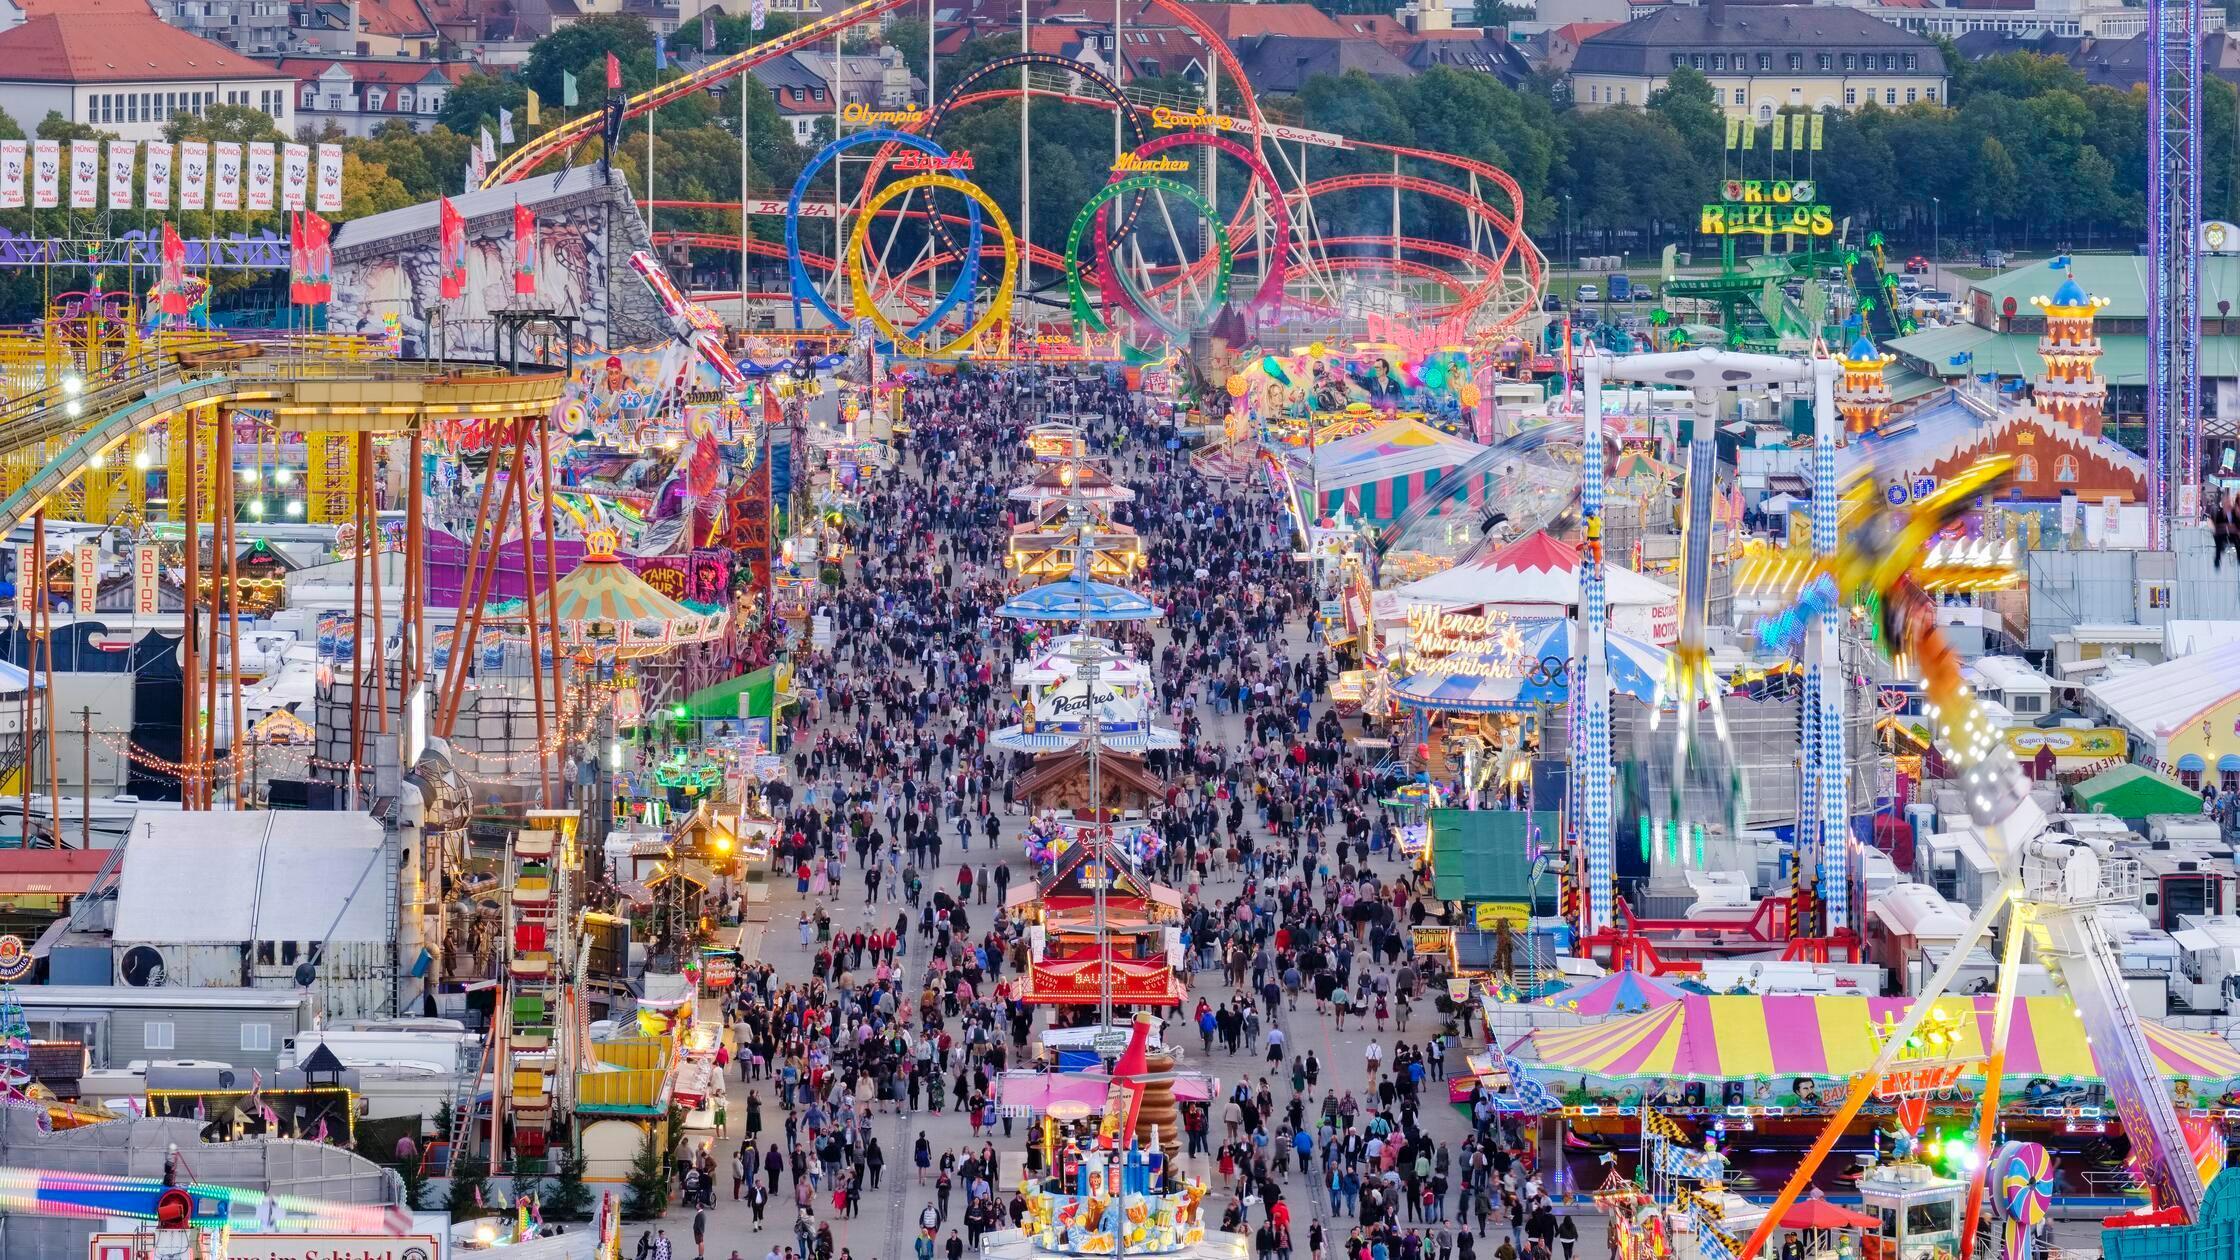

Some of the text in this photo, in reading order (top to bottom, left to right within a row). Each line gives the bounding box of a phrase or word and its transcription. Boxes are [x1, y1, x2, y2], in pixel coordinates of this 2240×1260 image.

[843, 103, 923, 125] Olympia
[1152, 106, 1231, 131] Looping
[1276, 127, 1336, 146] Looping
[893, 150, 974, 169] Barth
[1110, 152, 1190, 171] München
[1744, 180, 1791, 202] RIO
[754, 202, 830, 216] Bath
[1702, 205, 1834, 235] RAPIDOS
[1036, 335, 1071, 344] asse
[24, 548, 34, 611] ROTOR
[81, 549, 92, 612] ROTOR
[142, 550, 153, 613] ROTOR
[640, 568, 686, 588] FAHRT
[1417, 606, 1508, 636] Menzel's
[1417, 635, 1494, 653] Münchner
[1406, 654, 1514, 678] Zugspitzbahn
[1036, 973, 1059, 985] WIESN
[1142, 974, 1166, 986] WODKA
[1823, 1084, 1856, 1103] BAYE
